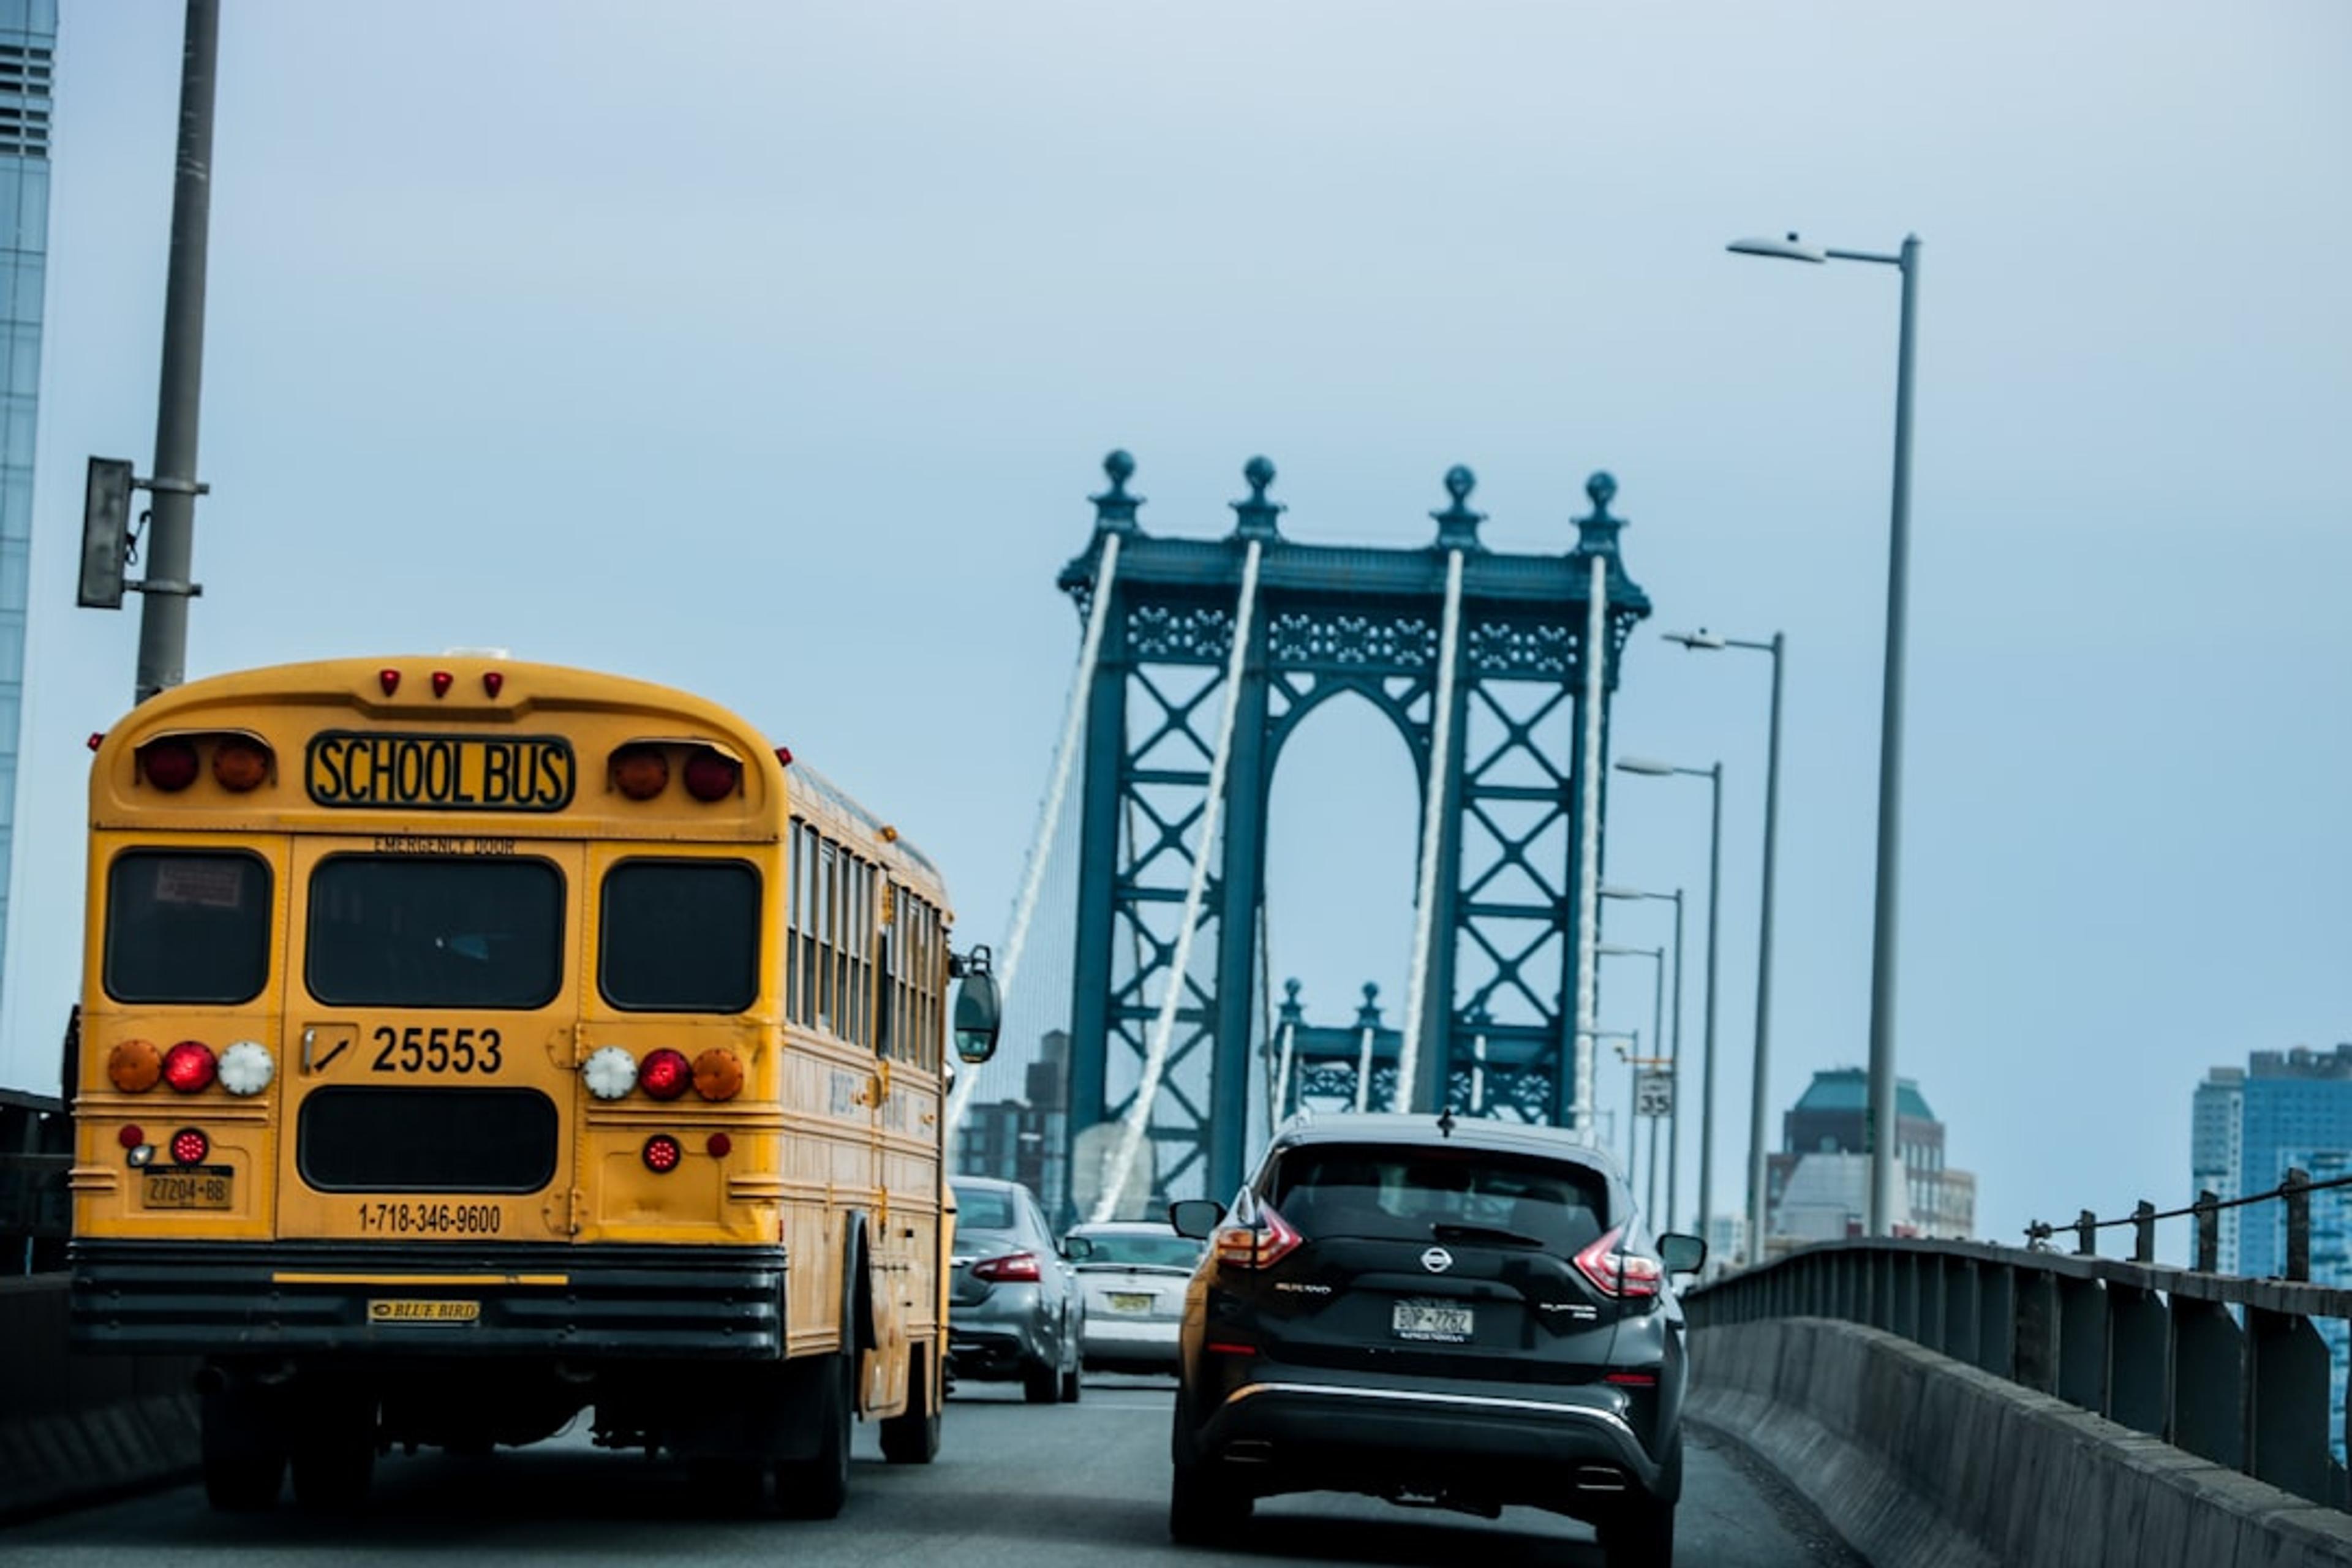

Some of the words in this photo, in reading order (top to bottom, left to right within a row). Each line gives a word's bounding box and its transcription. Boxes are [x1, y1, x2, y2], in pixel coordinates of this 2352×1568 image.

[317, 739, 473, 802] SCHOOL
[483, 743, 564, 804] BUS
[375, 837, 466, 853] EMERGENCY
[372, 1026, 502, 1073] 25553
[360, 1203, 500, 1233] 1-718-346-9600
